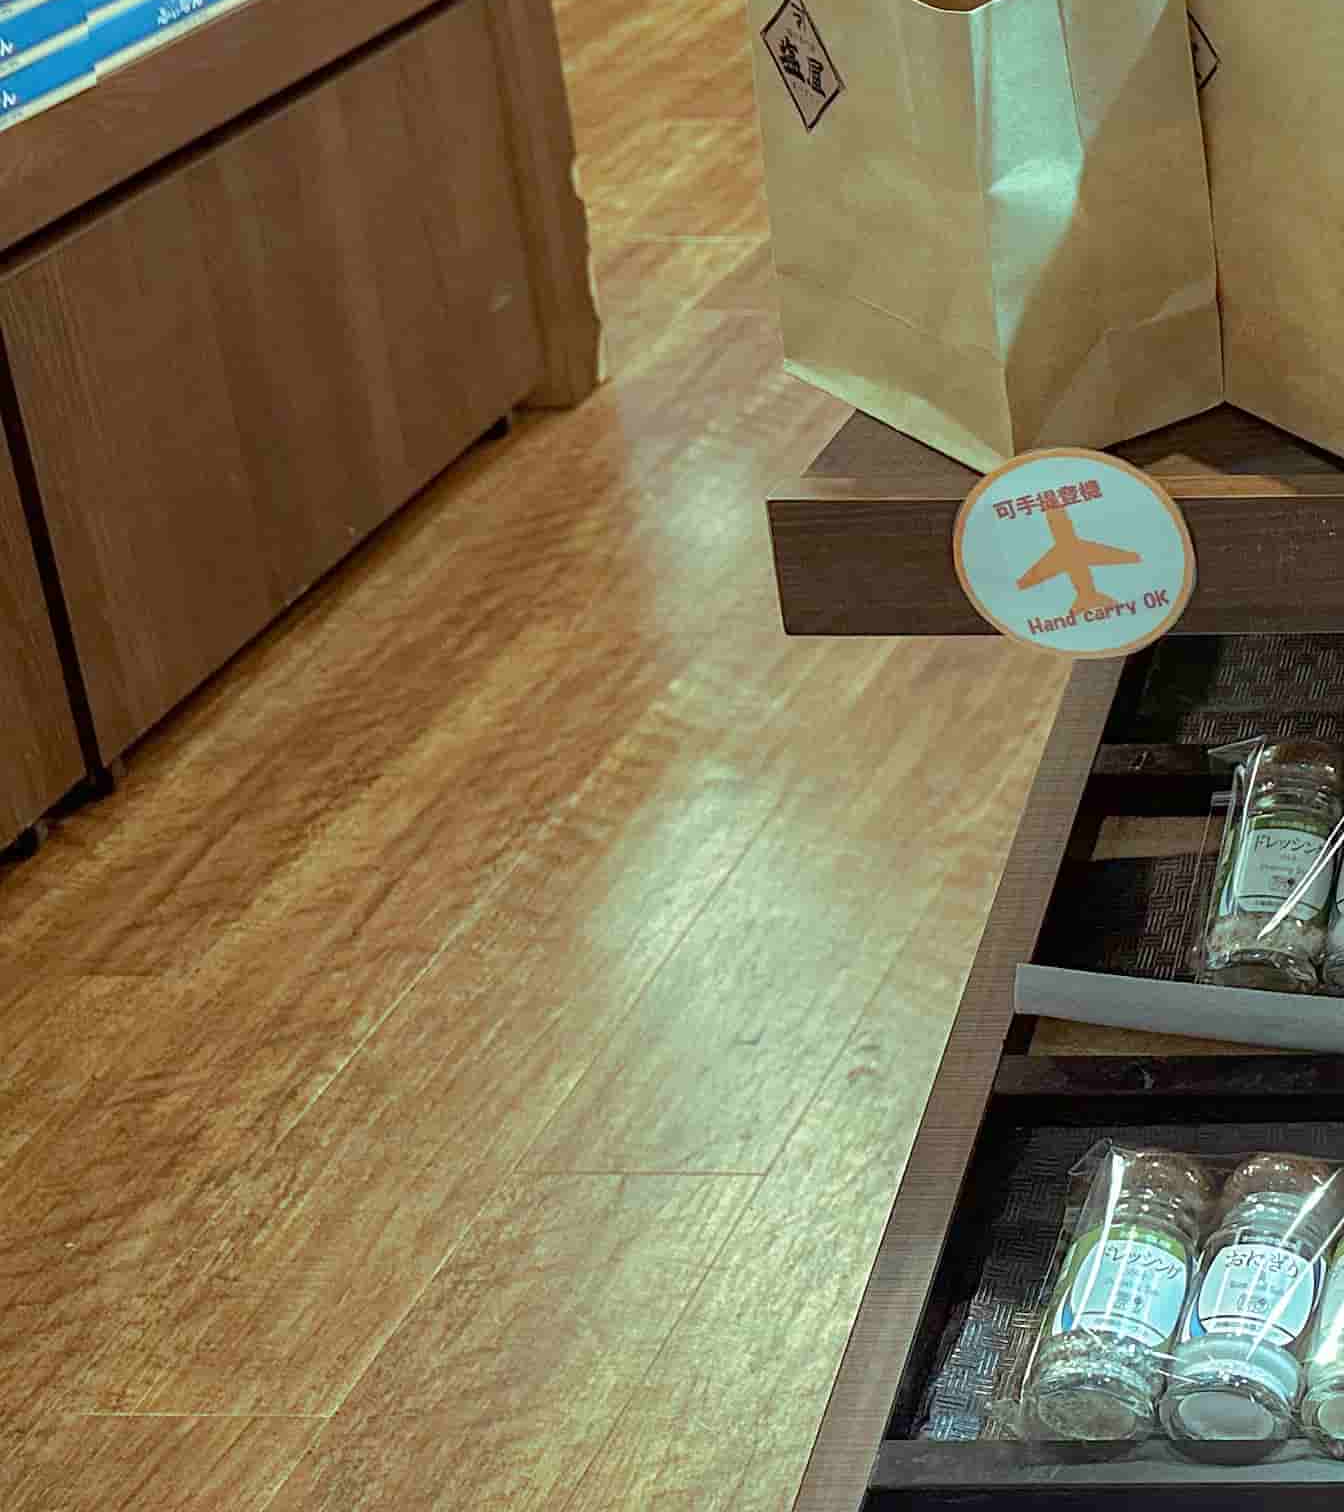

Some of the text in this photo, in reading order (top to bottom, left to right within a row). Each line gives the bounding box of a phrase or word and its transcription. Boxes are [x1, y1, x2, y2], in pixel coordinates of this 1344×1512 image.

[1027, 589, 1170, 634] Hand carry OK
